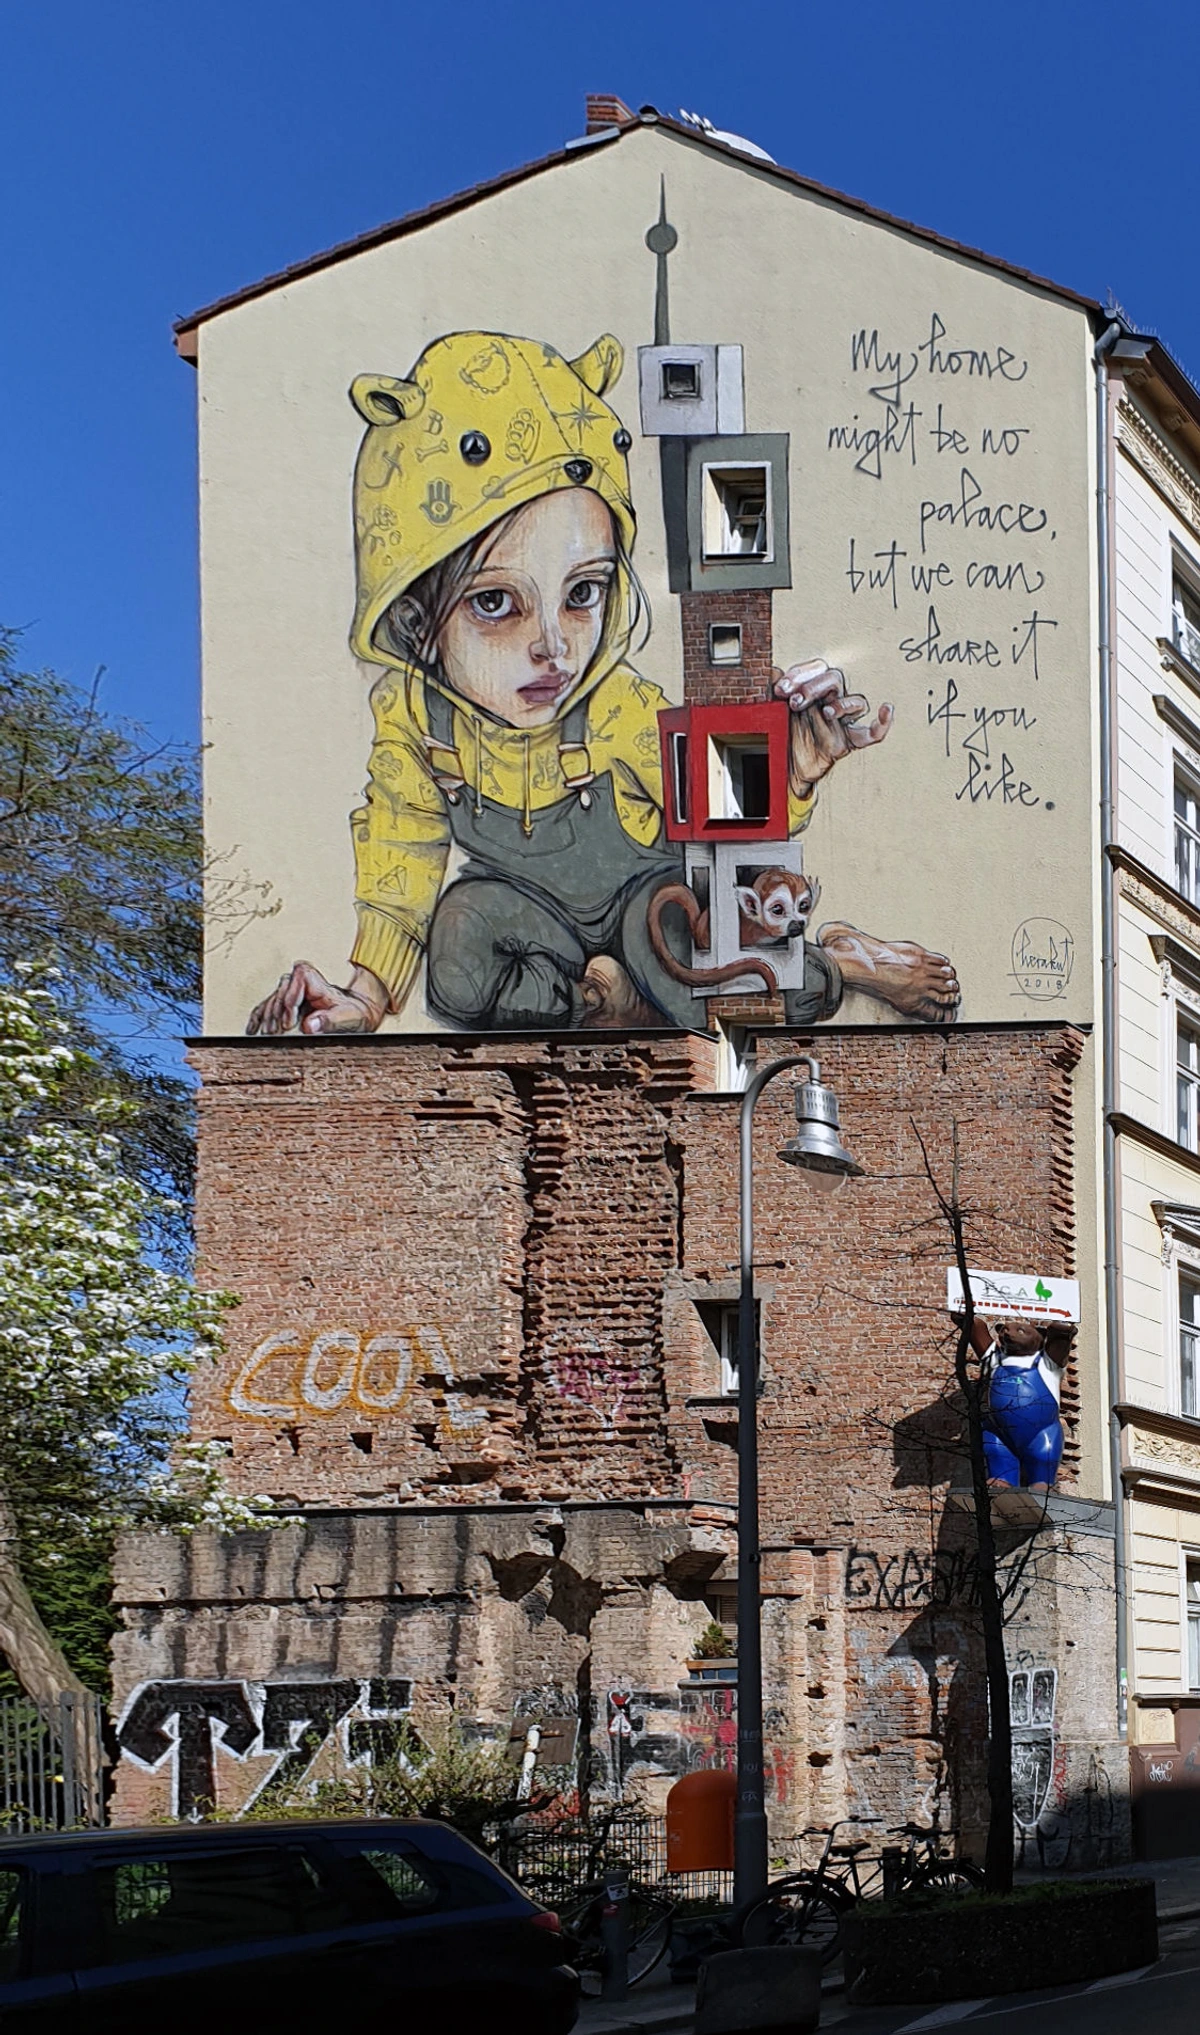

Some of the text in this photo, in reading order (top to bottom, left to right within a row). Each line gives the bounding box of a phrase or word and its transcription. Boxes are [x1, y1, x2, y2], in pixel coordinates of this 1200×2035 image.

[852, 312, 1028, 408] My home
[828, 401, 1030, 480] might be no
[920, 467, 1057, 554] palace,
[846, 538, 1044, 609] but we can
[899, 605, 1058, 680] share it
[928, 678, 1037, 758] if you
[955, 751, 1056, 811] like.
[1023, 978, 1063, 990] 2018
